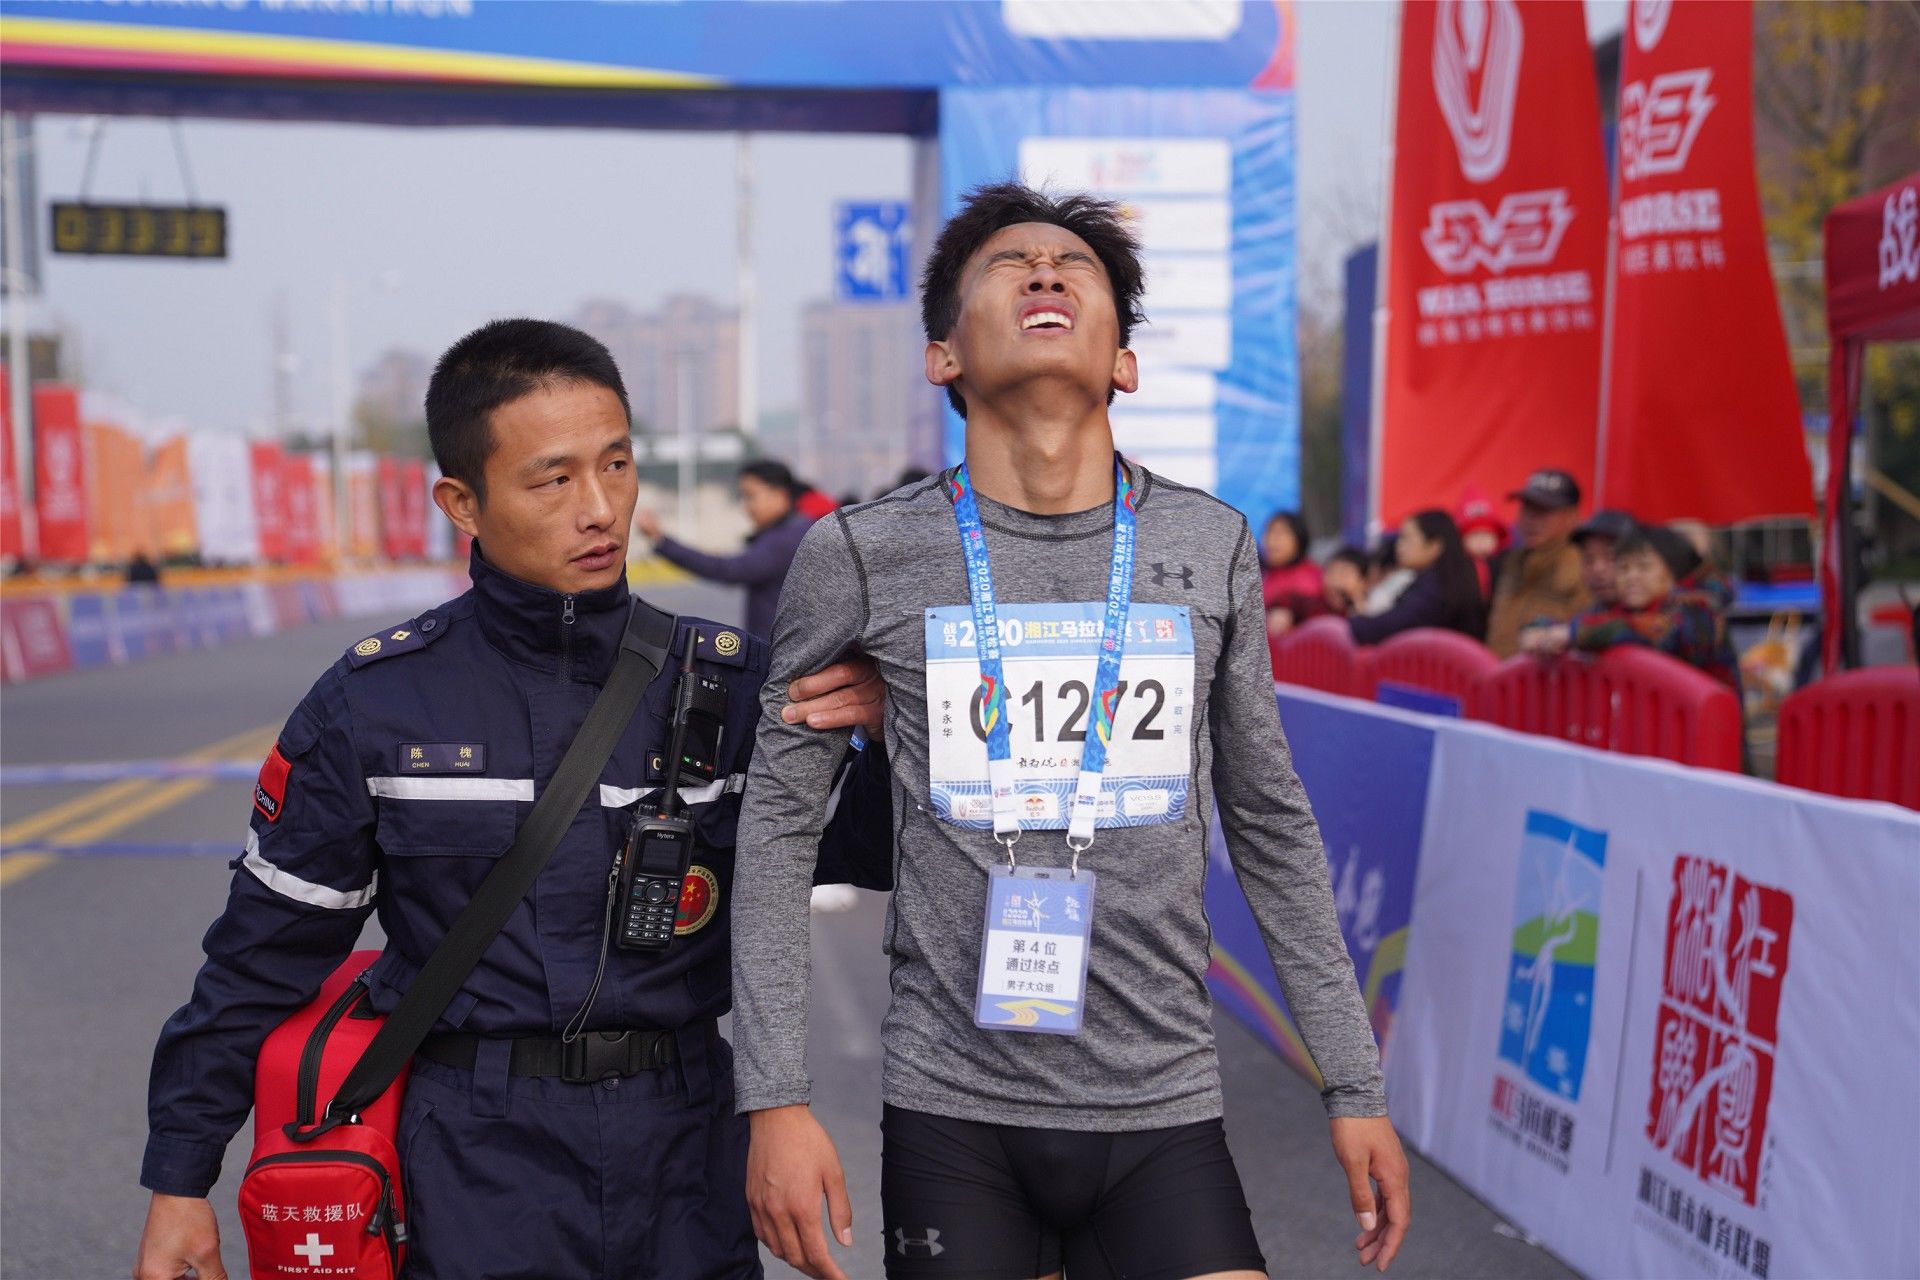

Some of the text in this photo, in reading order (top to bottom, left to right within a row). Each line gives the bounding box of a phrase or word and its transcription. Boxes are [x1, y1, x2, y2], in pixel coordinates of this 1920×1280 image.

[942, 700, 953, 738] 李永华
[411, 747, 423, 759] 陈
[656, 832, 675, 840] Hytera
[1006, 957, 1060, 974] 通过终点
[1007, 980, 1055, 993] 男子大众组
[261, 1203, 364, 1222] 蓝天救援队
[277, 1264, 309, 1274] FIRST
[336, 1266, 355, 1274] KIT
